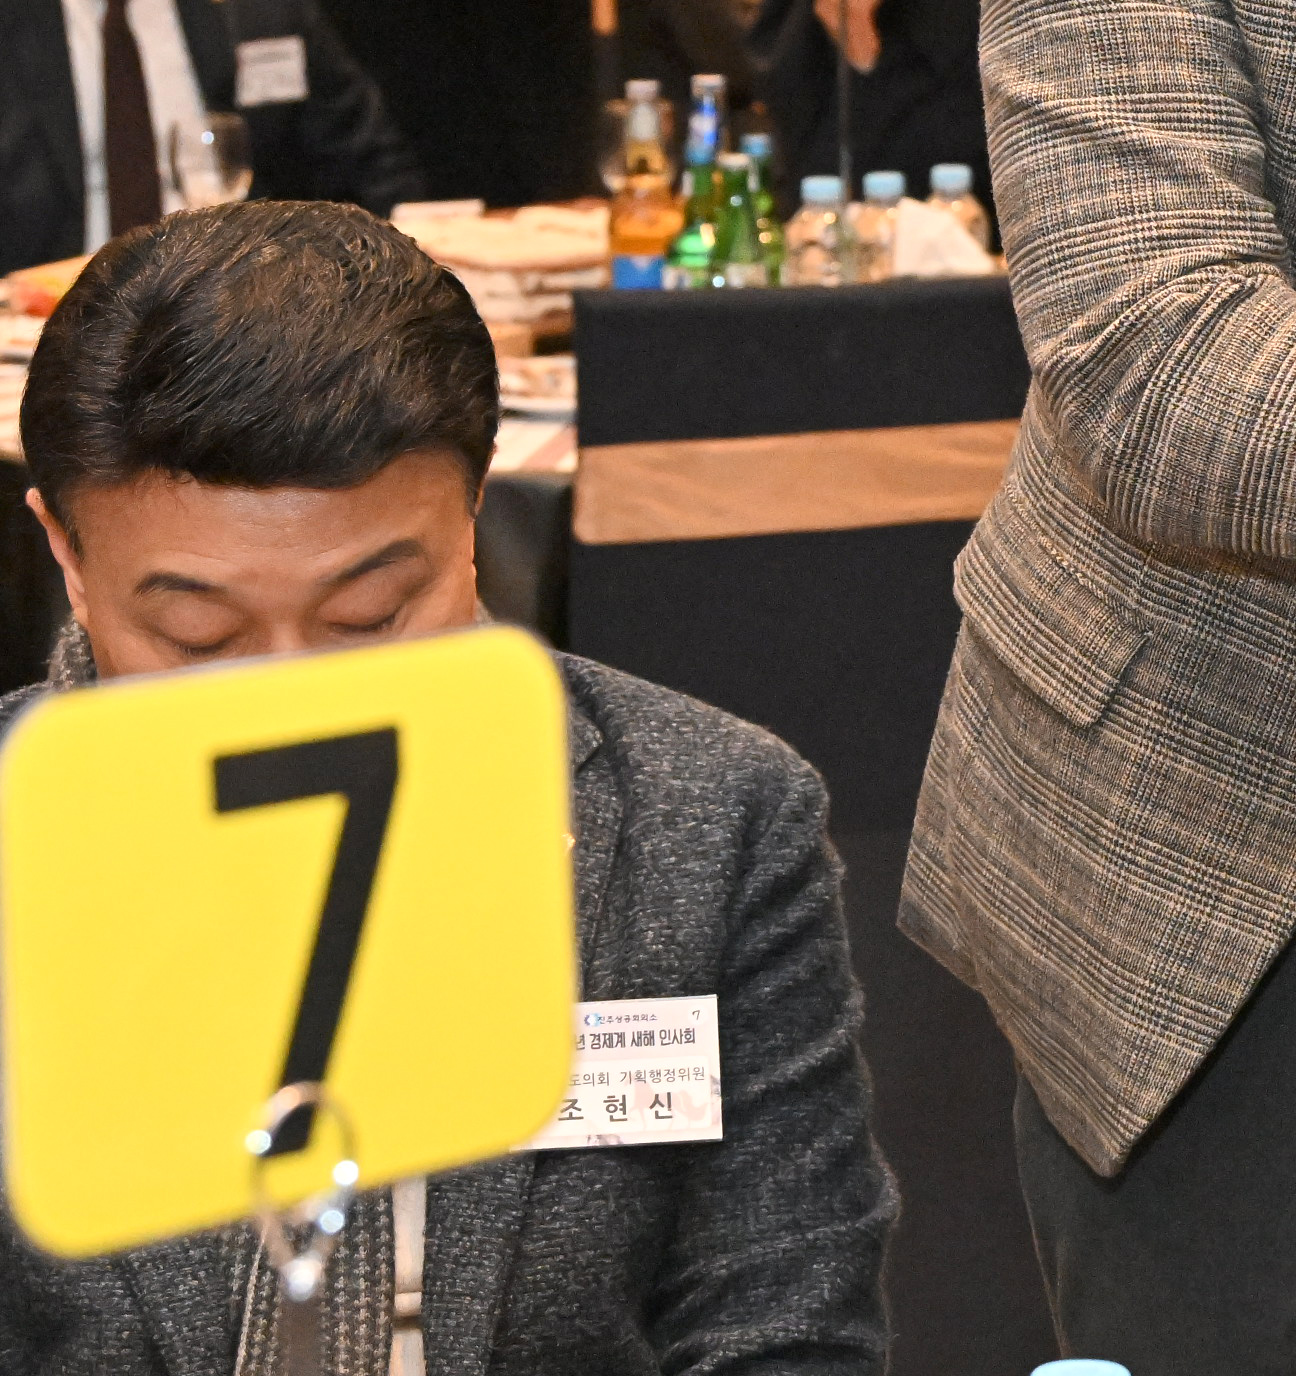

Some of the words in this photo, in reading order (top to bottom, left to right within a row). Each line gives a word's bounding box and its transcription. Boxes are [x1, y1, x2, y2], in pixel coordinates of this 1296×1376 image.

[210, 723, 405, 1158] 7
[691, 1009, 701, 1021] 7
[589, 1030, 626, 1050] 경제계
[631, 1029, 655, 1047] 새해
[658, 1027, 696, 1046] 인사회
[619, 1066, 706, 1086] 기획행정위원
